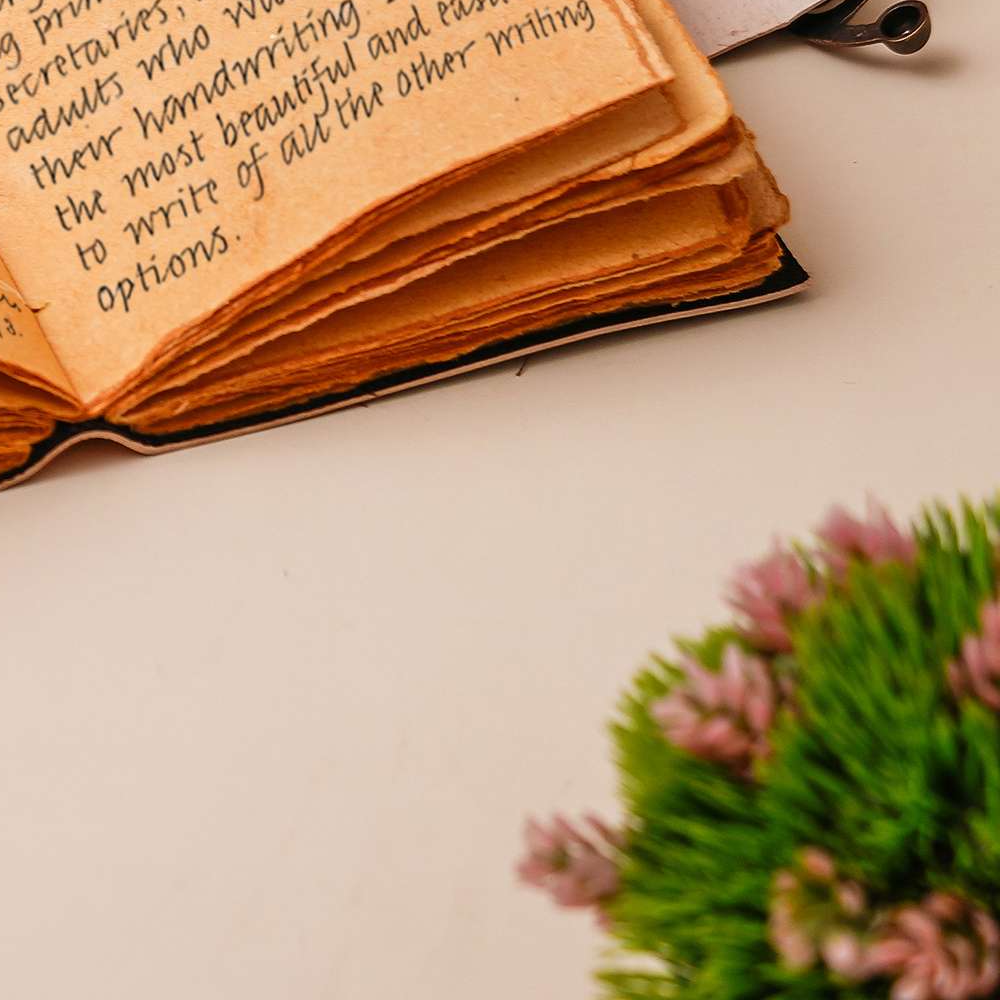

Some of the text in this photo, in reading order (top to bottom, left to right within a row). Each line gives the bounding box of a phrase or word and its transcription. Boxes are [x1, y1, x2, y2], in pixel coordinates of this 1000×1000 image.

[7, 71, 124, 151] adults
[137, 24, 211, 80] who
[55, 188, 107, 231] the
[122, 130, 206, 197] most
[216, 41, 356, 148] beautiful
[368, 6, 431, 60] and
[30, 126, 123, 190] their
[76, 238, 108, 271] to
[123, 178, 218, 246] write
[237, 142, 268, 201] of
[279, 112, 330, 166] all
[335, 80, 384, 130] the
[396, 40, 476, 98] other
[98, 225, 241, 314] options.
